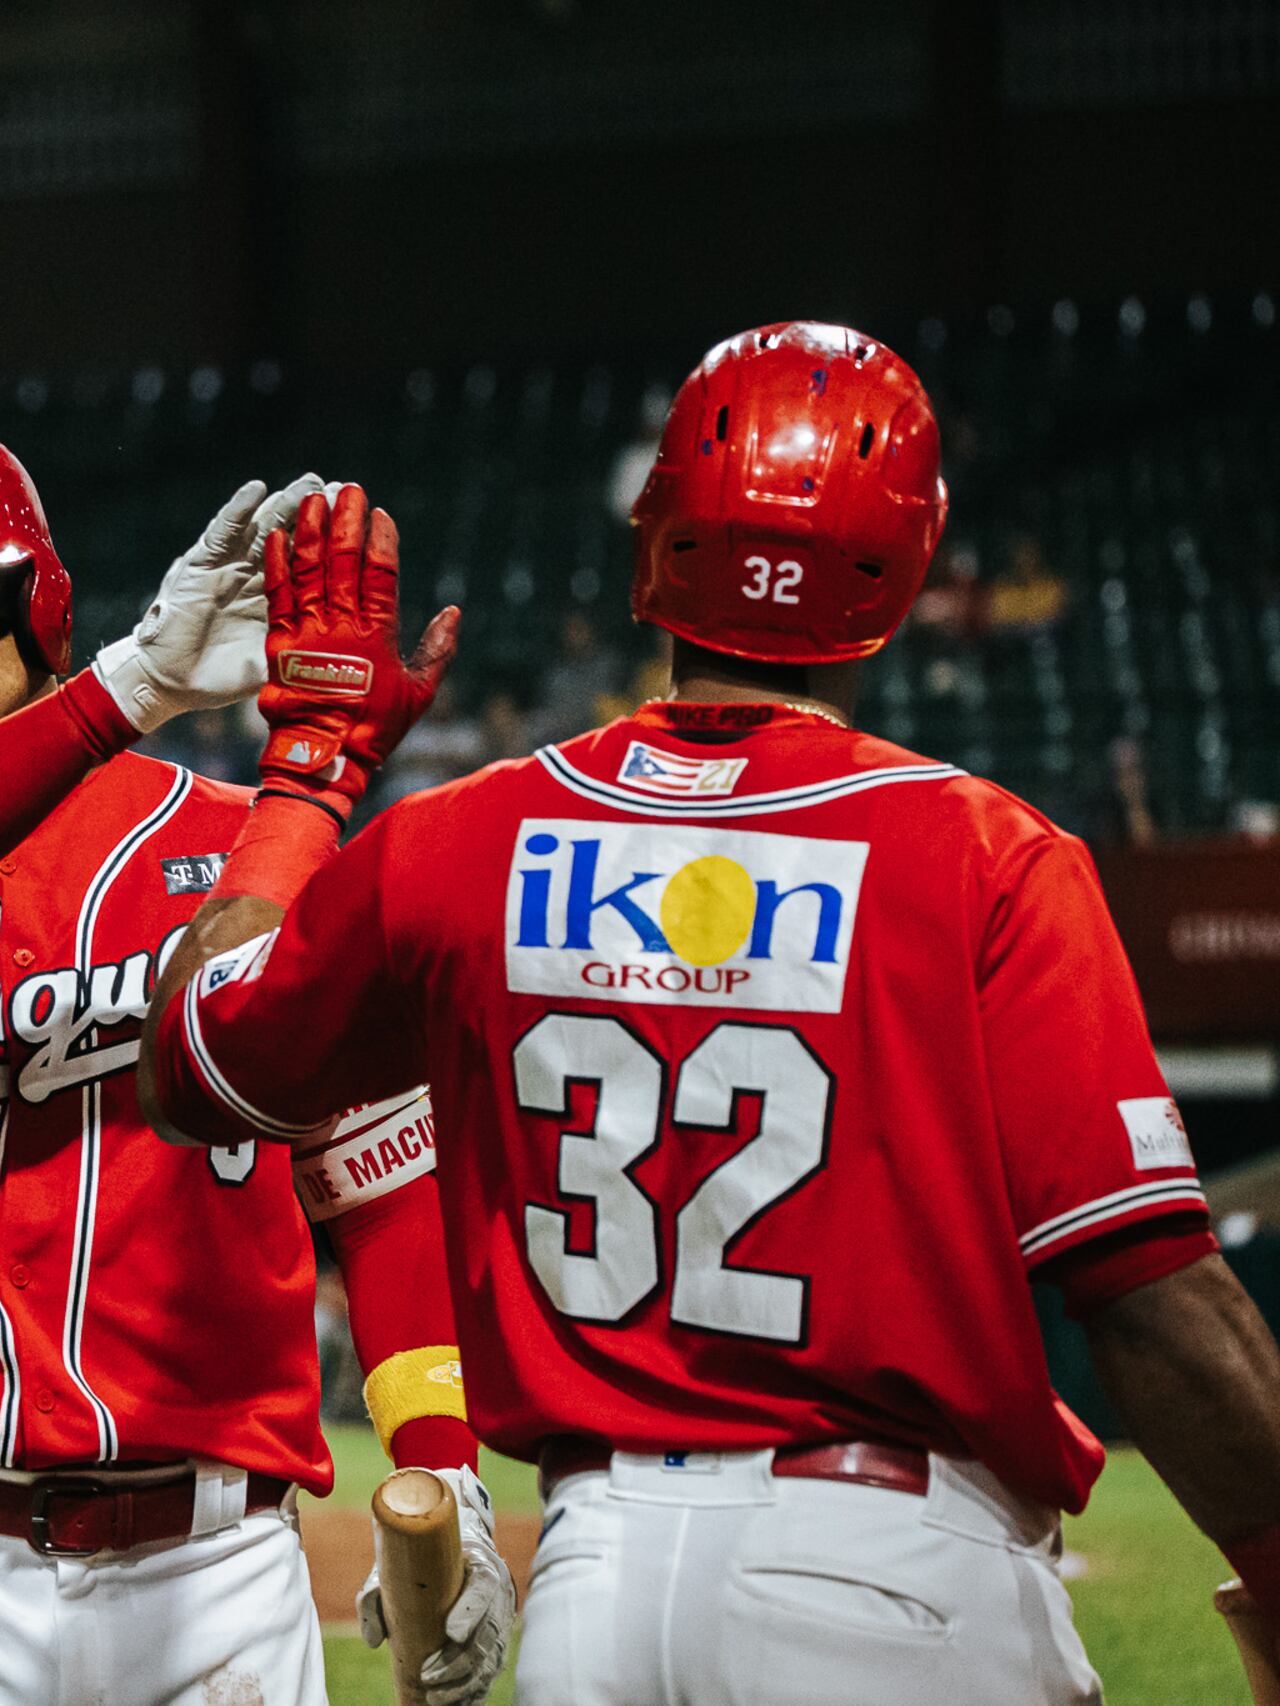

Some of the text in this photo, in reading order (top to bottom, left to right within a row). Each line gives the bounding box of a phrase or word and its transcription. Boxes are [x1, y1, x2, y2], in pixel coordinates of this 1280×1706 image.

[741, 556, 804, 604] 32
[285, 656, 365, 685] Franklin
[667, 705, 774, 727] NIKE PRO
[697, 760, 738, 791] 21
[581, 961, 751, 994] GROUP
[301, 1168, 342, 1204] DE
[512, 1012, 836, 1348] 32
